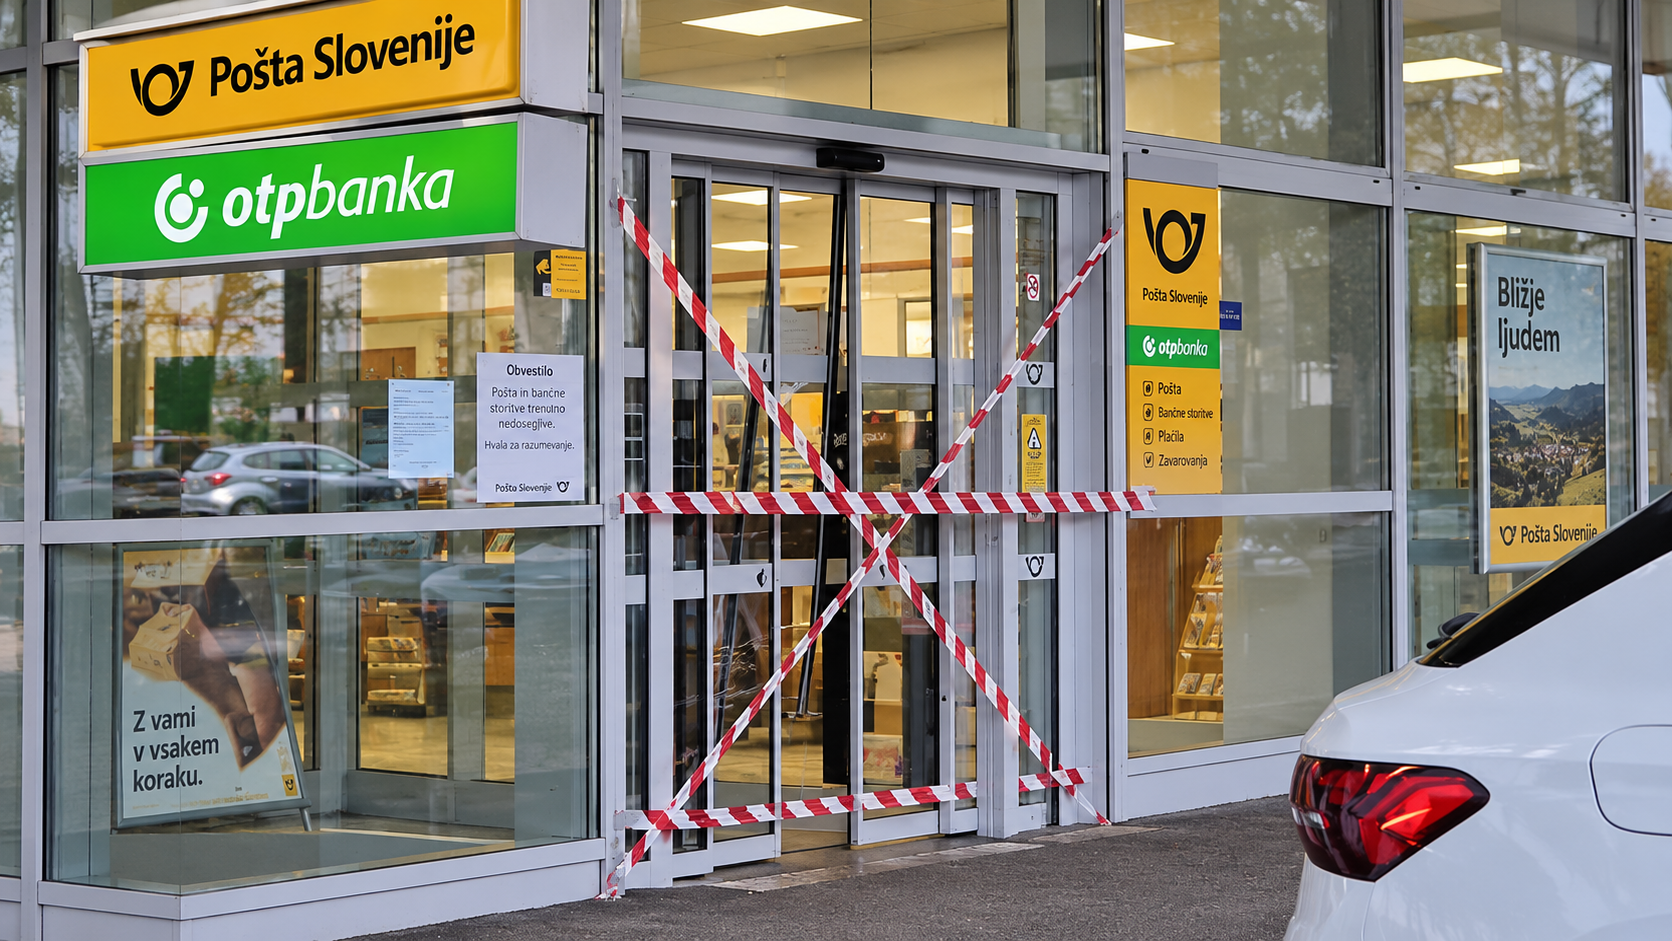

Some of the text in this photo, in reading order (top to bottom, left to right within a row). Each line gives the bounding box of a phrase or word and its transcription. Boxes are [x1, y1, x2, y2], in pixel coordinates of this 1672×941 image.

[210, 13, 475, 97] Pošta Slovenije
[222, 155, 455, 240] otpbanka
[1142, 287, 1209, 308] Pošta Slovenije
[1498, 276, 1545, 317] Bližje
[1498, 317, 1560, 359] ljudem
[506, 363, 554, 377] Obvestilo
[491, 386, 518, 398] Pošta
[520, 387, 529, 398] in
[1158, 382, 1182, 395] Pošta
[484, 440, 575, 452] Hvala za razumevanje.
[1158, 454, 1208, 470] Zavarovanja
[1521, 524, 1551, 544] Pošta
[133, 705, 196, 733] Z vami
[133, 734, 219, 762] v vsakem
[133, 764, 204, 793] koraku.
